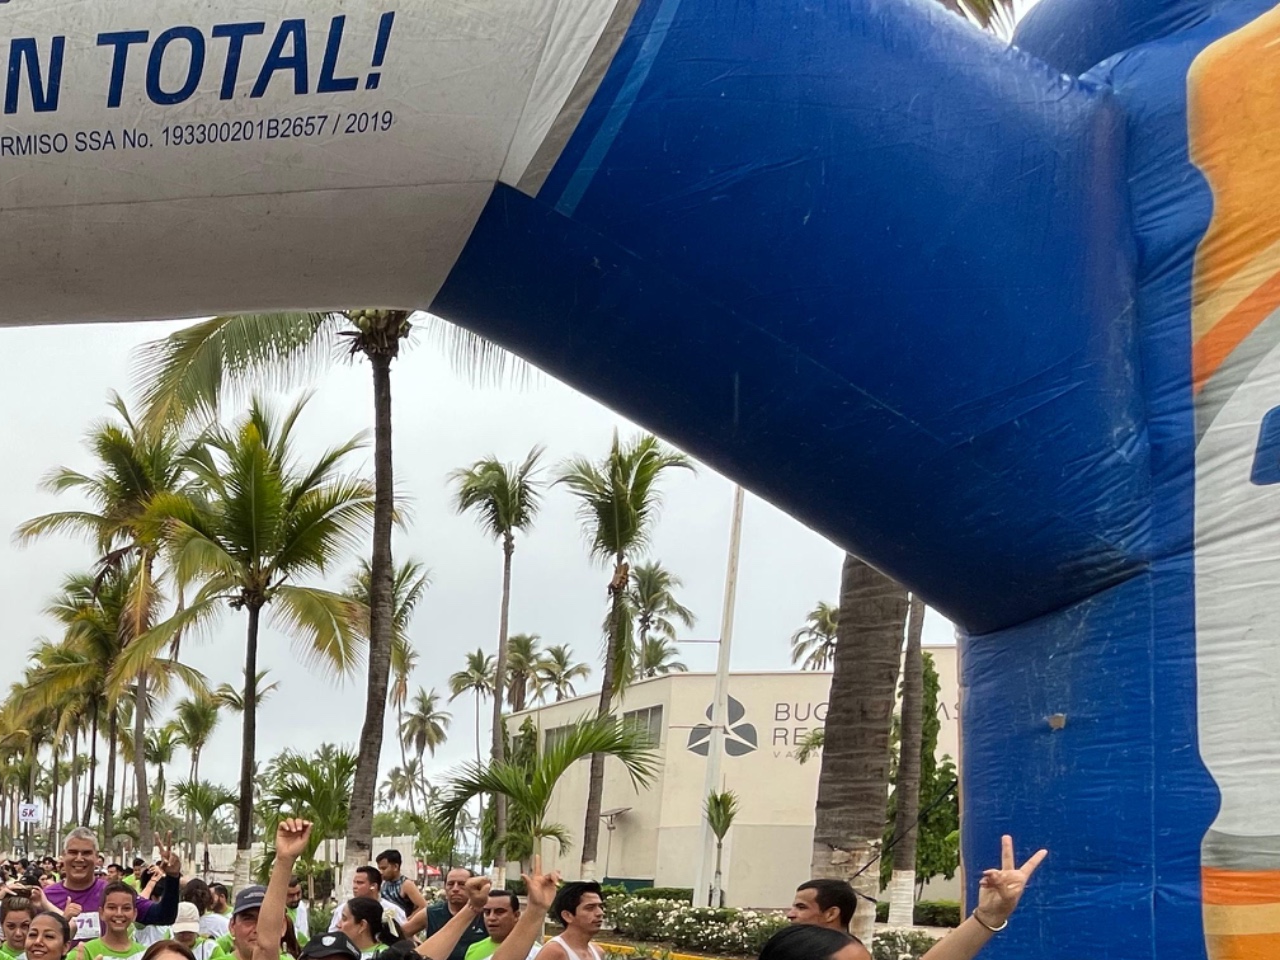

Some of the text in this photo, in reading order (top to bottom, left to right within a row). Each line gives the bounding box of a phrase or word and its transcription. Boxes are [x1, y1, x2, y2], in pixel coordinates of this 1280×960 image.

[97, 11, 396, 109] TOTAL!
[75, 130, 116, 153] SSA
[122, 128, 154, 150] No.
[162, 115, 328, 147] 193300201B2657
[345, 110, 393, 134] 2019
[22, 808, 36, 818] 5K
